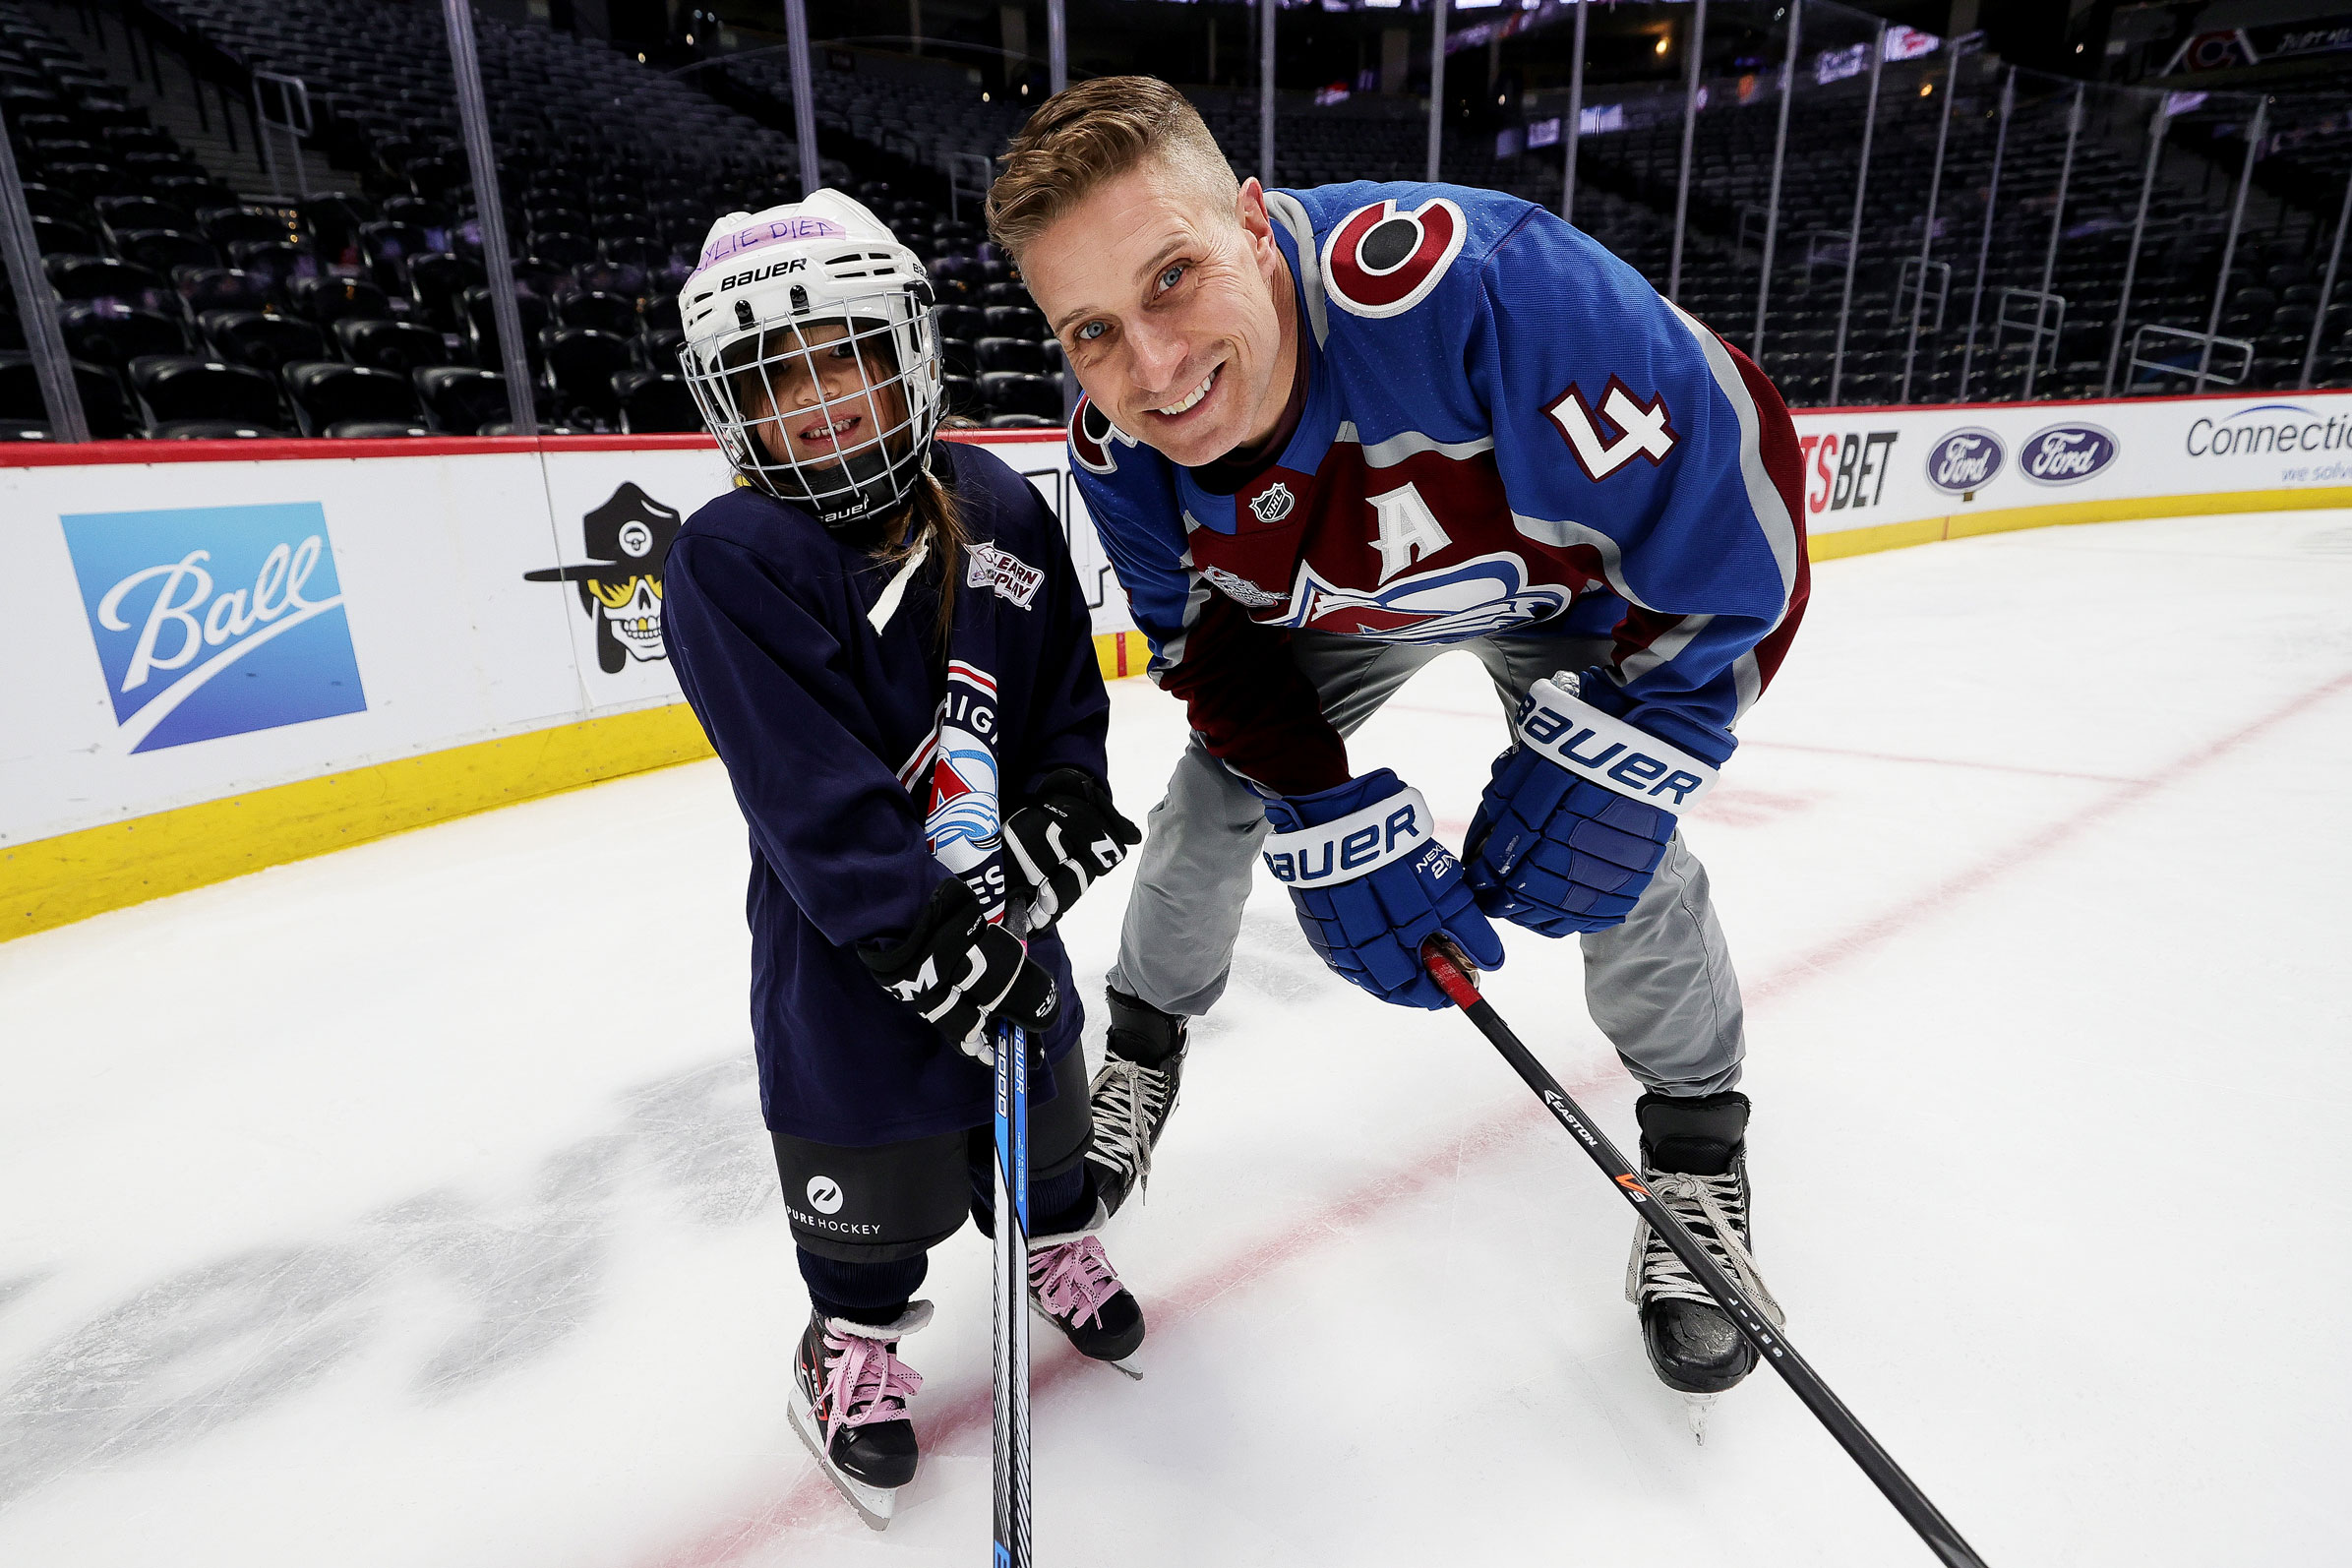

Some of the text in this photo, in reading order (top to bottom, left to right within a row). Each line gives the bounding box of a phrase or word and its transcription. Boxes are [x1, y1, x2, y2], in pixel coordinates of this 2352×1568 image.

[1540, 373, 1681, 483] 4
[1937, 437, 1988, 484] Ford
[2031, 432, 2100, 477] Ford
[1266, 494, 1283, 518] NHL
[1365, 481, 1453, 586] A
[97, 534, 344, 694] Ball
[1551, 1101, 1598, 1148] EASTON
[817, 1218, 881, 1235] HOCKEY
